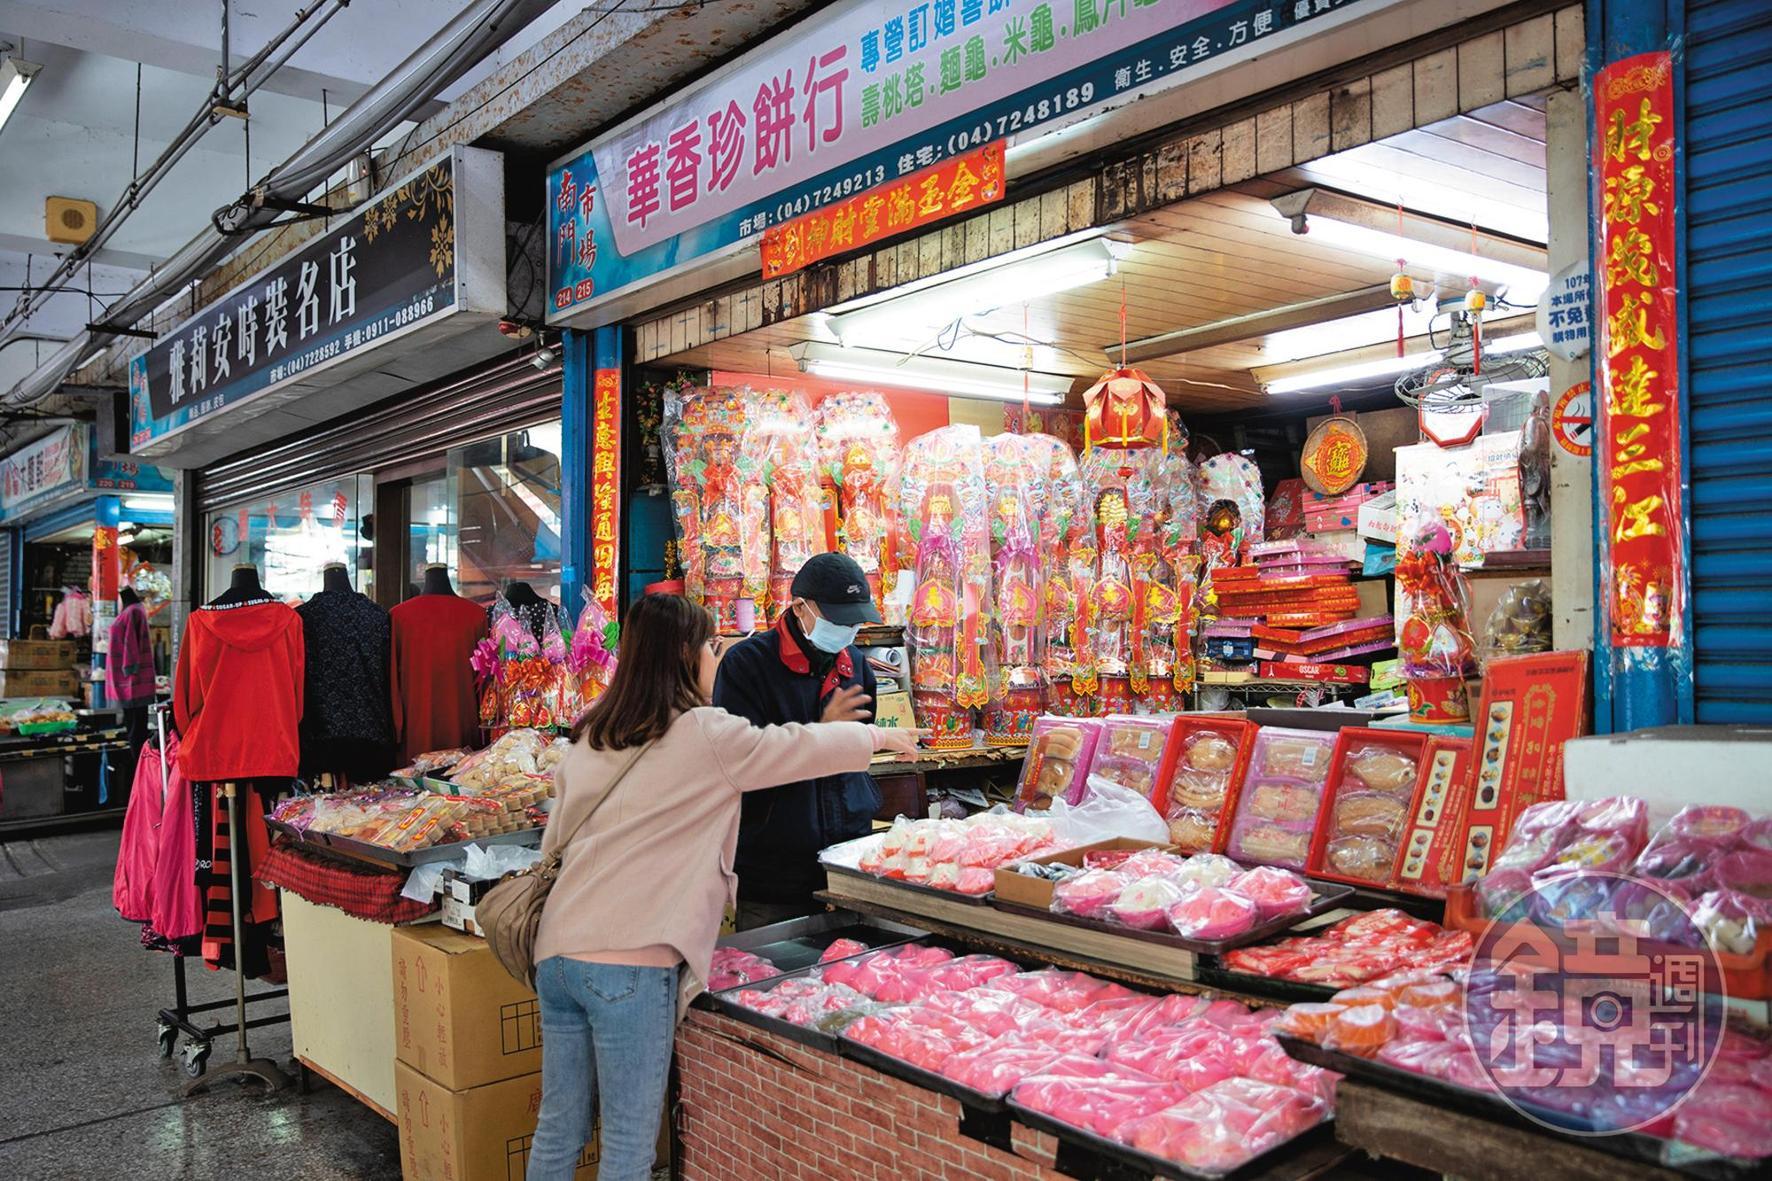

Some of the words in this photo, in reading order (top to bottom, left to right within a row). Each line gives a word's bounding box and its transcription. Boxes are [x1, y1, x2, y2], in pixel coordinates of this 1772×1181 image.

[627, 44, 849, 229] 華香珍餅行
[557, 169, 577, 267] 南門
[578, 183, 597, 271] 市場
[168, 235, 357, 405] 雅莉安時裝名店
[557, 290, 571, 307] 214
[576, 282, 591, 299] 215
[1551, 288, 1590, 307] 本場所
[1552, 326, 1590, 343] 購物用
[1603, 97, 1668, 546] 財源茂盛達三江
[593, 391, 618, 602] 生意興隆通四海
[1299, 665, 1320, 674] OSCAR
